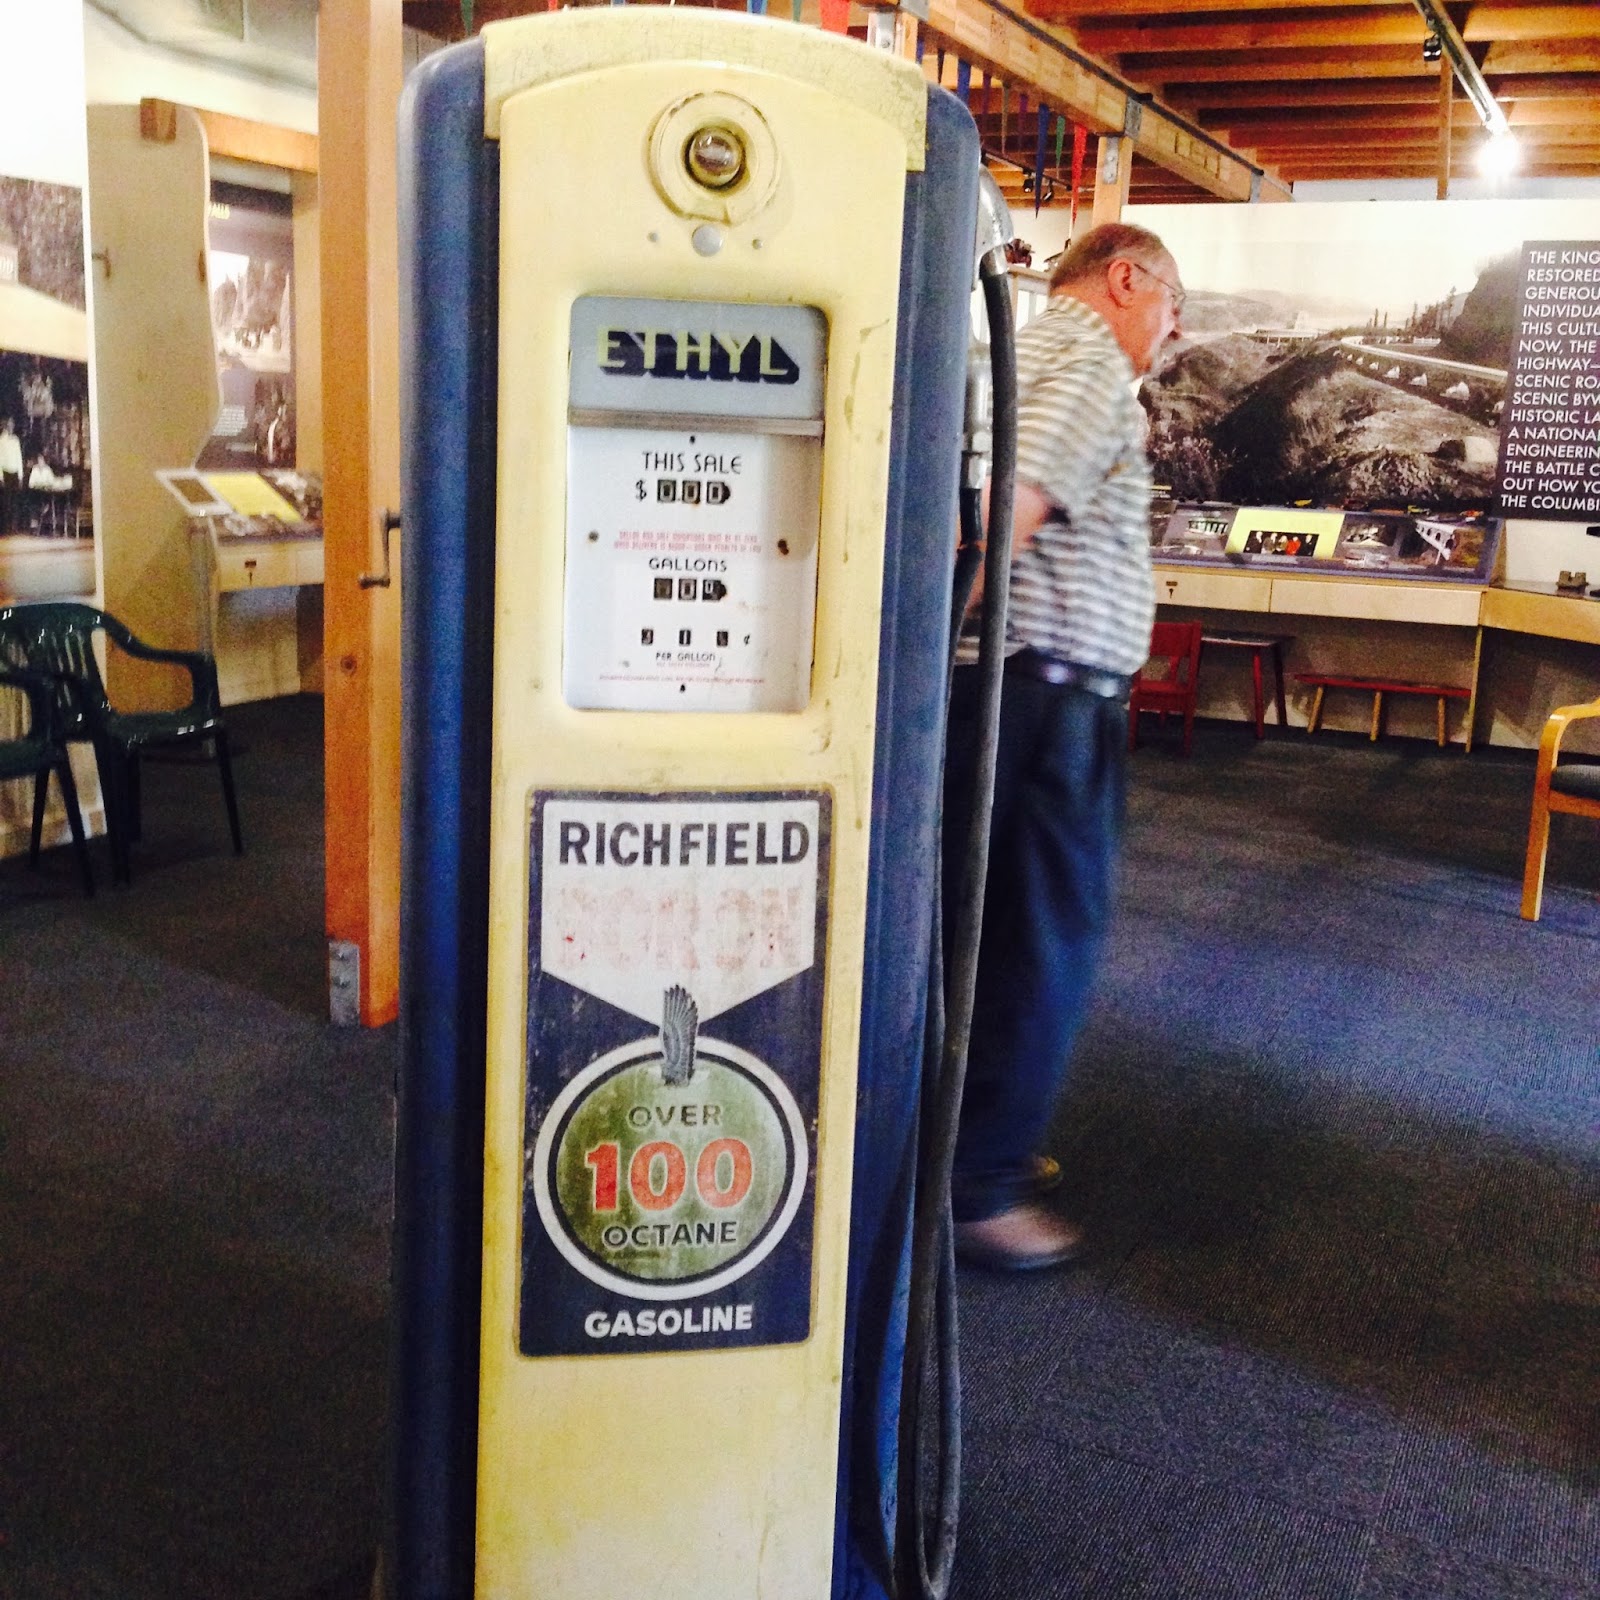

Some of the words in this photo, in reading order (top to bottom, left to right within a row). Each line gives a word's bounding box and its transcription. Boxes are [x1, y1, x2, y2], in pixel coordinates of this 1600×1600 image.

[1529, 250, 1557, 264] THE
[1561, 250, 1600, 265] KING
[1527, 268, 1600, 282] RESTORED
[1525, 286, 1600, 300] GENEROU
[1521, 321, 1552, 335] THIS
[1519, 339, 1563, 354] NOW,
[1569, 340, 1597, 353] THE
[597, 325, 799, 385] ETHYL
[1515, 374, 1571, 388] SCENIC
[1575, 375, 1600, 389] RO
[1512, 392, 1568, 406] SCENIC
[1510, 409, 1580, 423] HISTORIC
[1508, 426, 1519, 439] A
[1506, 443, 1600, 458] ENGINEERIN
[642, 451, 684, 472] THIS
[693, 453, 742, 474] SALE
[1504, 461, 1531, 474] THE
[1536, 462, 1585, 476] BATTLE
[1502, 478, 1535, 491] OUT
[1538, 479, 1579, 492] HOW
[1501, 494, 1528, 508] THE
[648, 557, 728, 573] GALLONS
[655, 652, 673, 661] PER
[677, 652, 716, 662] GALLON
[559, 820, 811, 867] RICHFIELD
[628, 1103, 723, 1128] OVER
[585, 1137, 754, 1212] 100
[603, 1220, 738, 1247] OCTANE
[584, 1304, 754, 1339] GASOLINE
